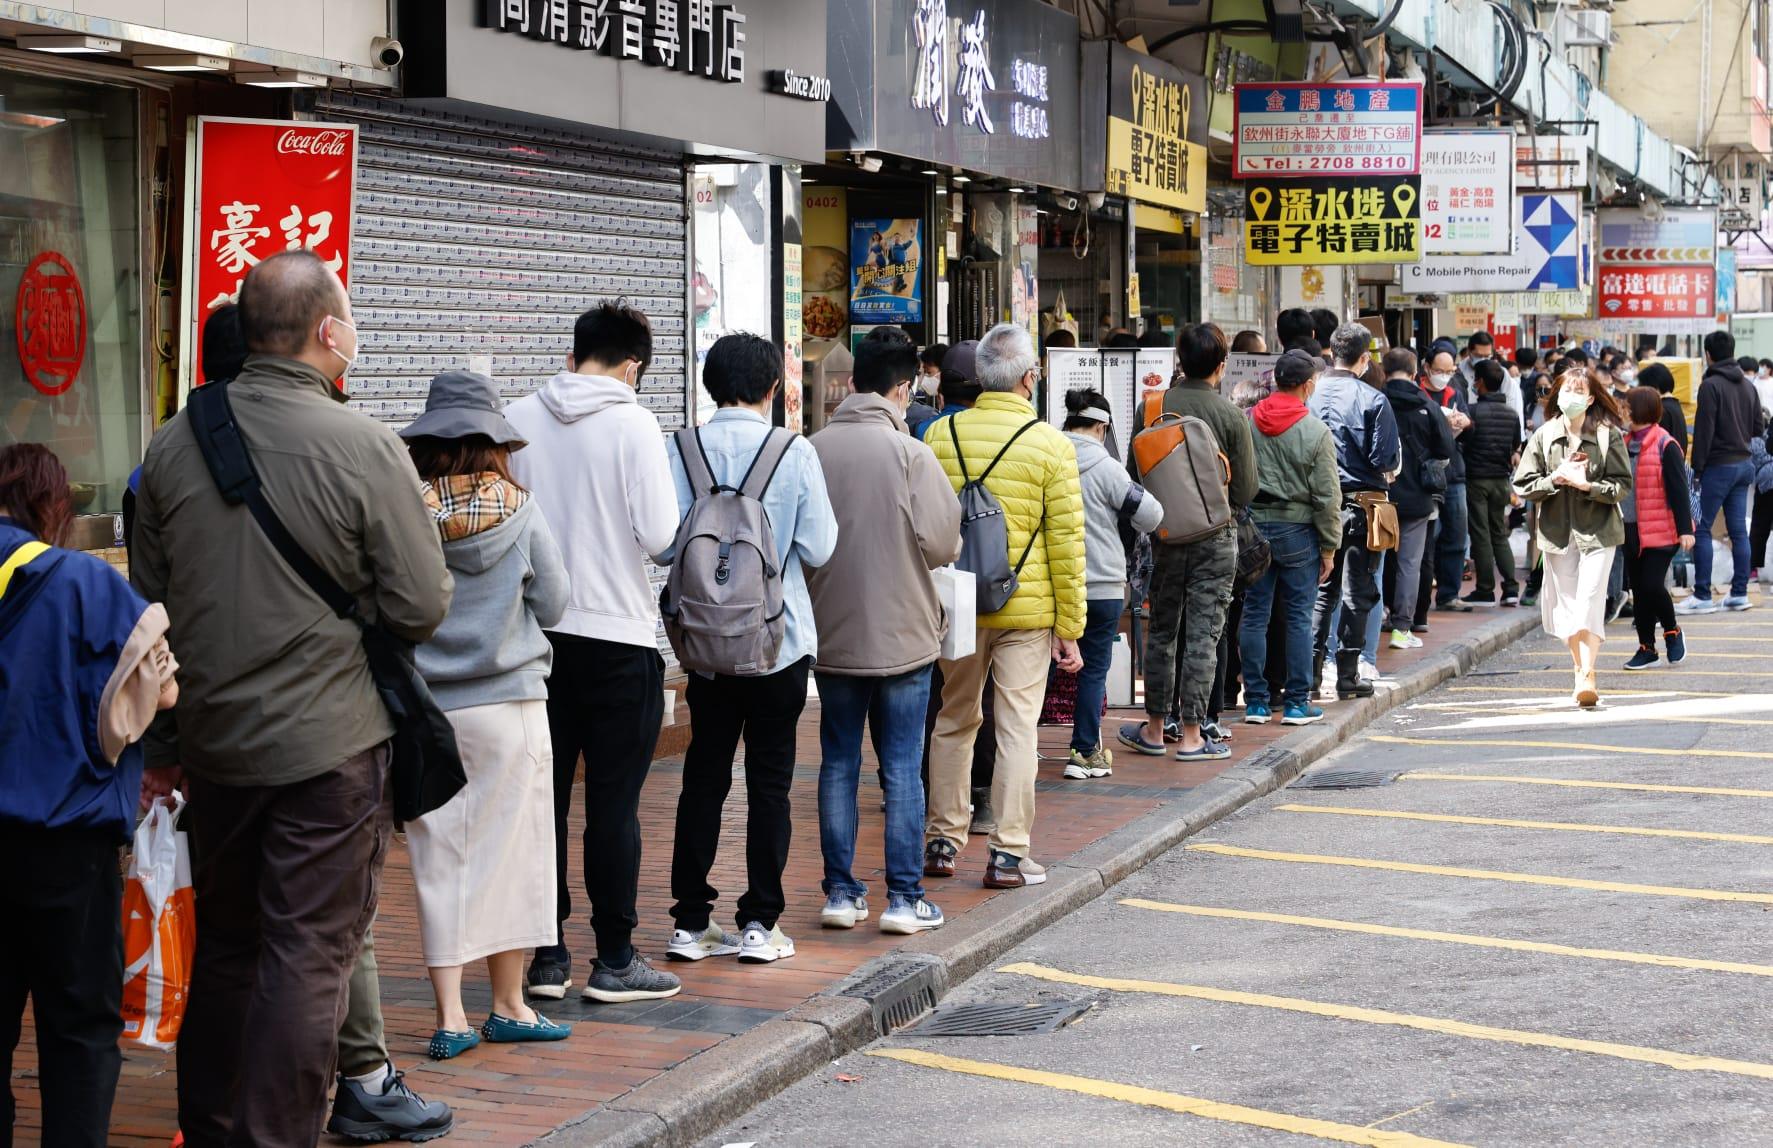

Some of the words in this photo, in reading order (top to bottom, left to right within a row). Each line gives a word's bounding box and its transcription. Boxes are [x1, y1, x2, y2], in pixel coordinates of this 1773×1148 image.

[784, 69, 808, 96] Since
[809, 75, 831, 101] 2010
[1143, 71, 1181, 139] 深水埗
[1266, 90, 1390, 112] 金鵬地產
[277, 129, 349, 156] Coca-Cola
[1131, 128, 1189, 195] 電子特賣城
[1310, 157, 1354, 169] 2708
[1362, 157, 1406, 169] 8810
[1422, 151, 1496, 165] 理有限公司
[806, 196, 838, 209] 0402
[1279, 187, 1386, 221] 深水埗
[1250, 222, 1415, 254] 電子特賣城
[1412, 266, 1421, 277] C
[1426, 267, 1461, 277] Mobile
[1463, 267, 1496, 276] Phone
[1498, 265, 1532, 276] Repair
[1602, 273, 1710, 295] 富達電話卡
